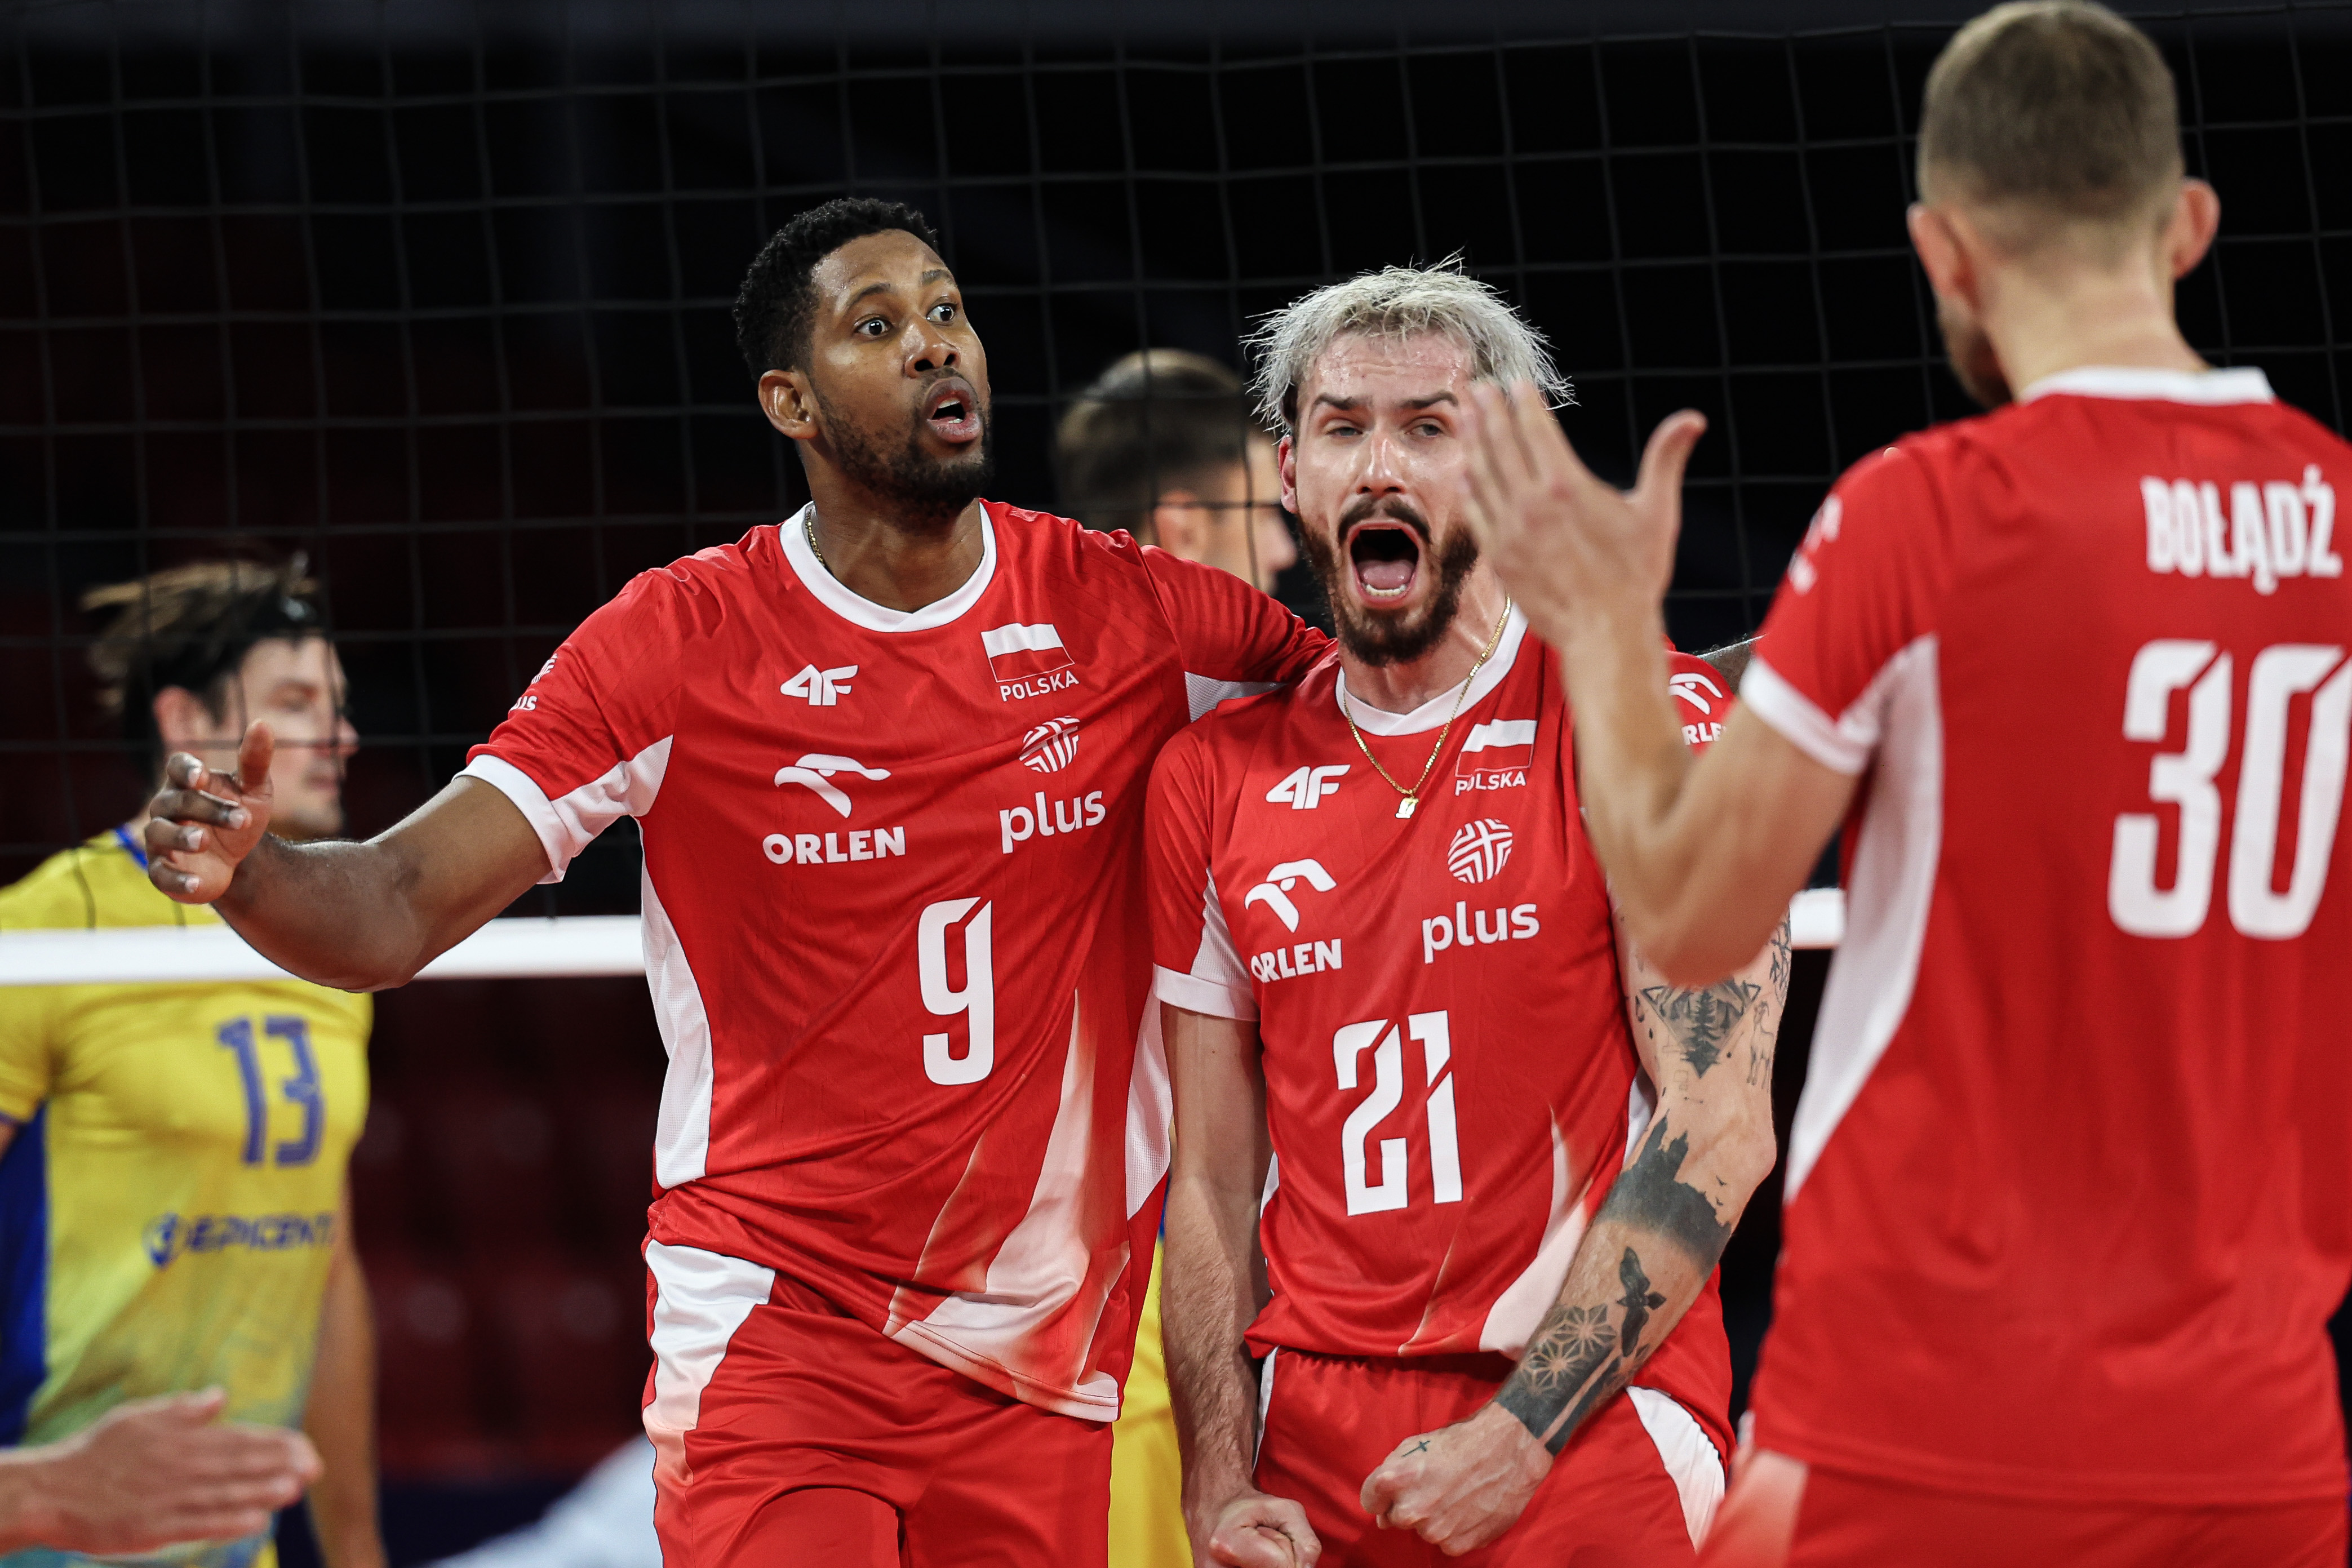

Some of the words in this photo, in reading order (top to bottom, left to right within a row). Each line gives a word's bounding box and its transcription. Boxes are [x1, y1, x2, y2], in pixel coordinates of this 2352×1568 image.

[780, 664, 858, 706] 4F
[1000, 670, 1079, 702] POLSKA
[1681, 722, 1727, 745] RLE
[1266, 764, 1351, 810] 4F
[2108, 639, 2352, 939] 30
[762, 826, 906, 864] ORLEN
[999, 790, 1106, 854] plus
[1422, 900, 1540, 964] plus
[1250, 938, 1342, 983] ORLEN
[918, 896, 994, 1085] 9
[216, 1016, 326, 1169] 13
[1333, 1010, 1462, 1216] 21
